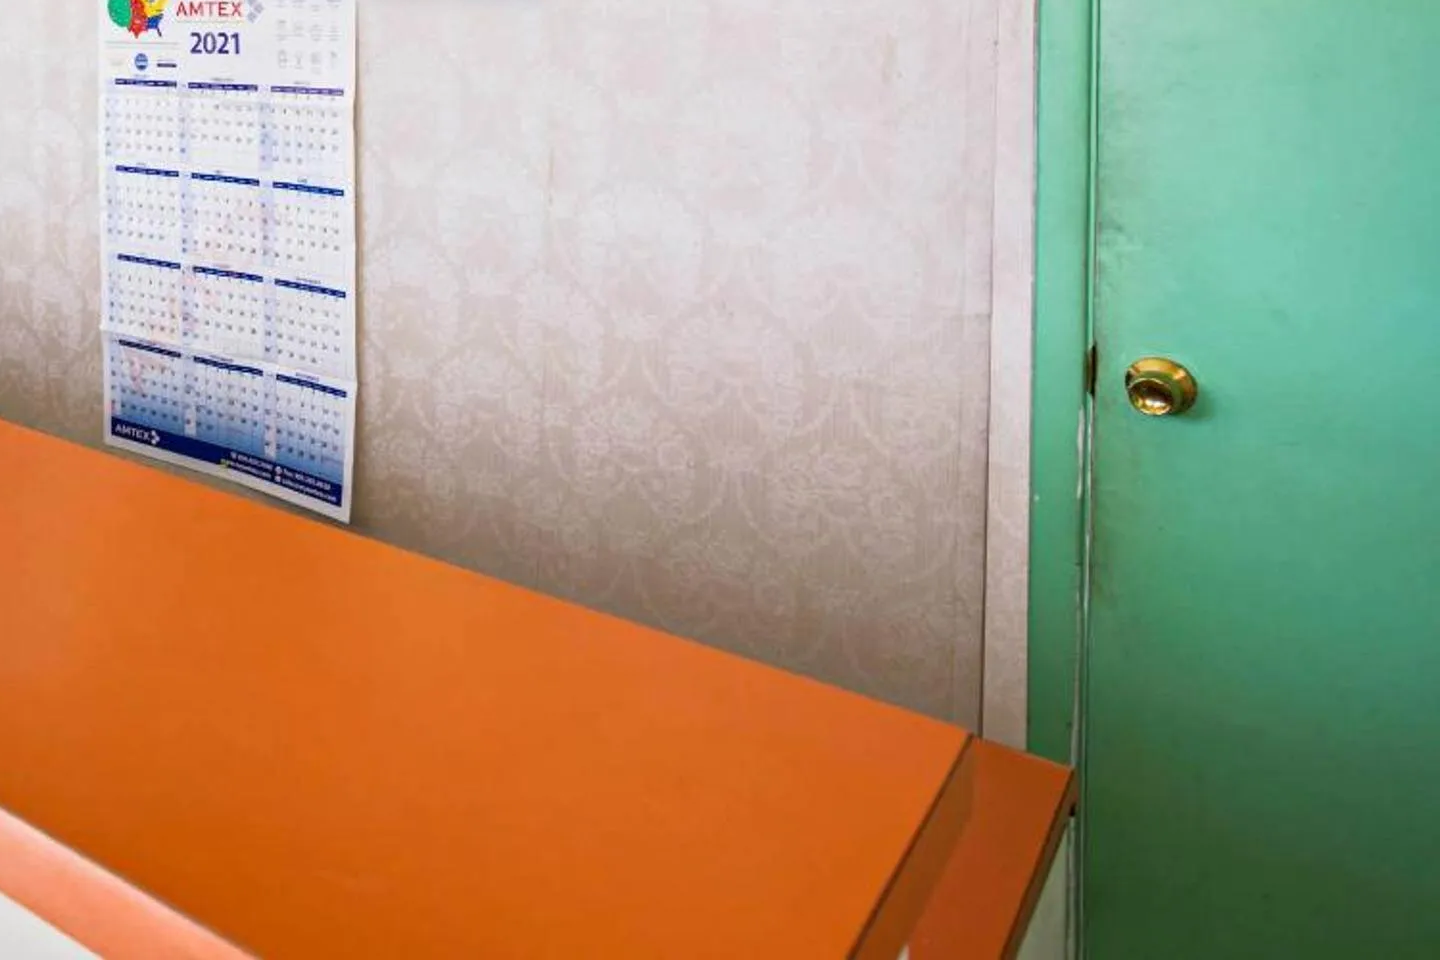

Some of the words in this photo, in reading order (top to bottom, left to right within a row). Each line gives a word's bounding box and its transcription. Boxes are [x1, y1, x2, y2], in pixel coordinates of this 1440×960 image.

[176, 1, 243, 18] AMTEX
[190, 32, 241, 54] 2021
[115, 423, 150, 441] AMTEX
